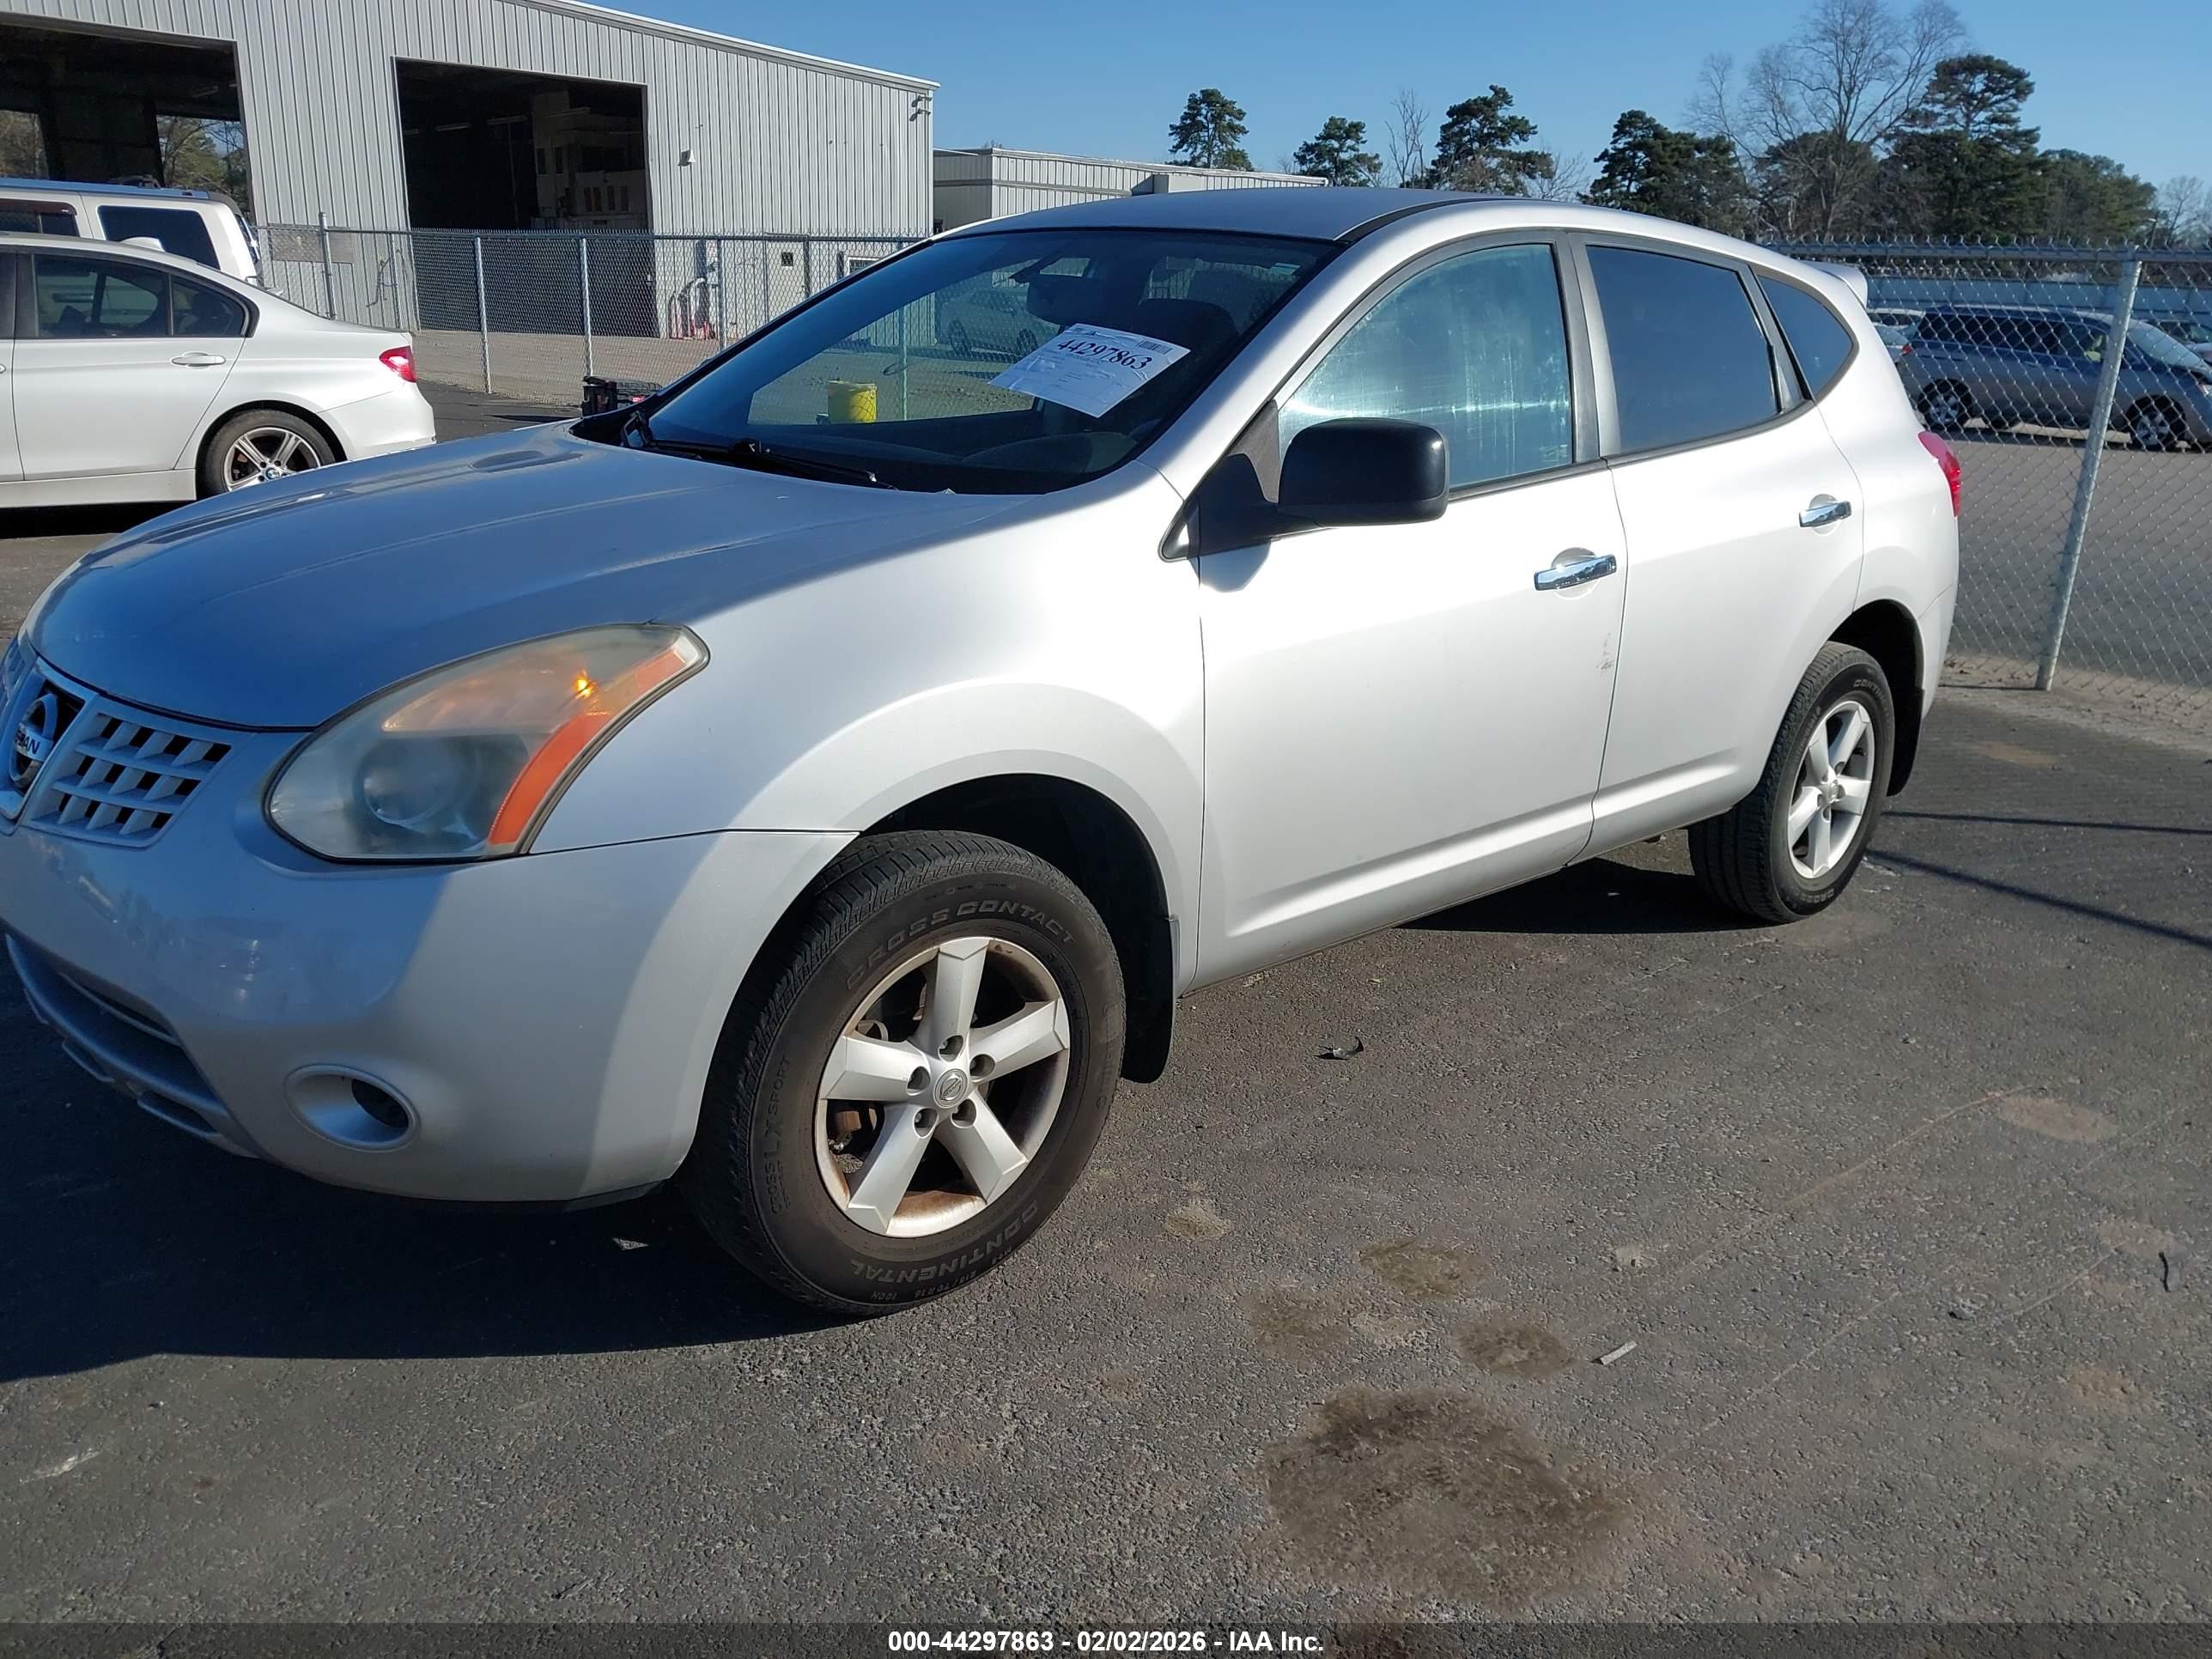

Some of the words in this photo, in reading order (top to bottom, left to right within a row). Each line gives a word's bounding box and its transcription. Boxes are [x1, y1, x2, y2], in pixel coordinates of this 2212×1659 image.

[1056, 337, 1153, 370] 44297863
[957, 900, 1075, 945] CONTACT
[850, 1200, 1038, 1285] CONTINENTAL
